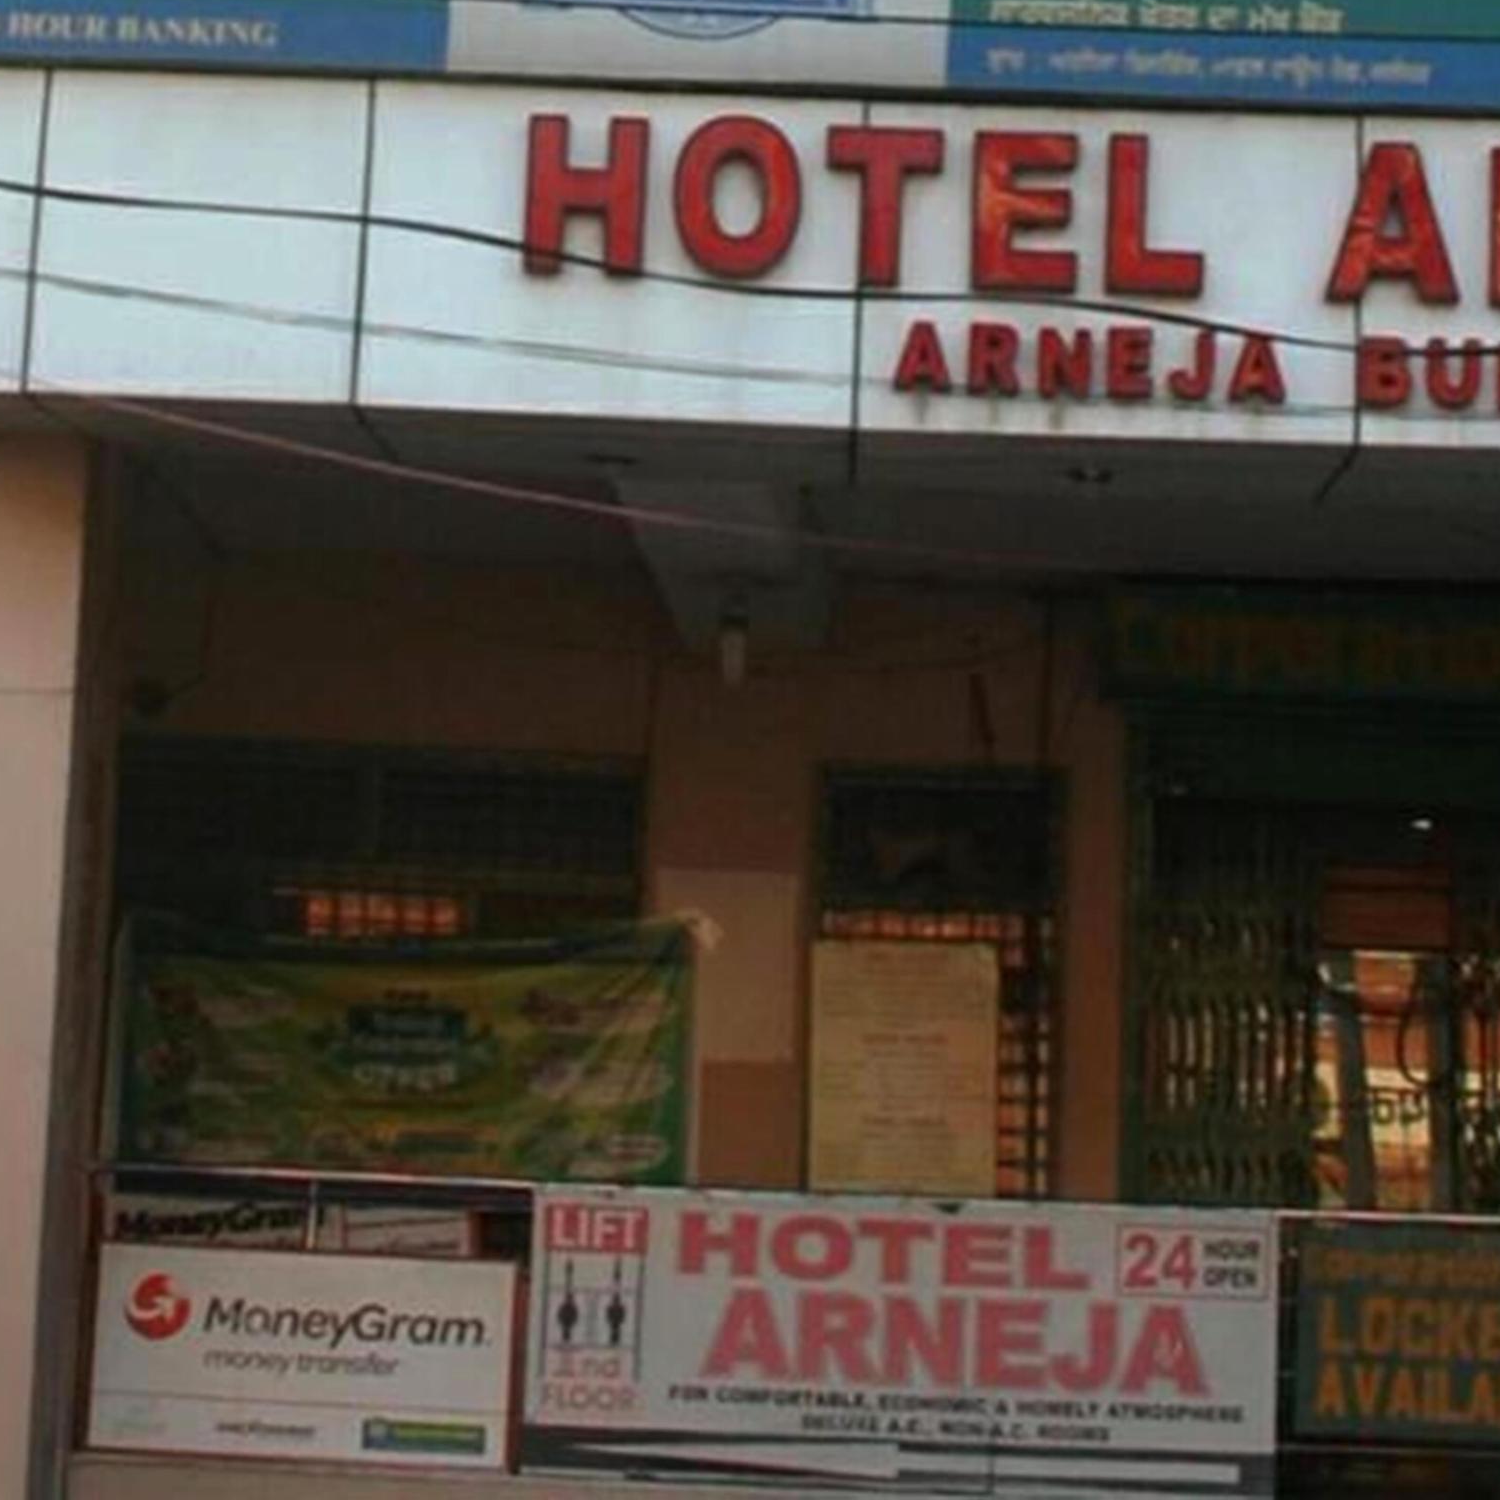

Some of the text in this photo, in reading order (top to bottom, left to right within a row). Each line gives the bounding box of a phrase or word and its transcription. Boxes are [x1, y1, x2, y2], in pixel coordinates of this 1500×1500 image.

[6, 10, 107, 42] HOUR
[116, 13, 279, 48] BANKING
[522, 114, 1204, 298] HOTEL
[894, 317, 1289, 404] ARNEJA
[552, 1208, 644, 1249] LIFT
[679, 1211, 1089, 1290] HOTEL
[1122, 1233, 1198, 1290] 24
[1204, 1240, 1260, 1262] HOUR
[1204, 1264, 1258, 1288] OPEN
[203, 1297, 486, 1349] MoneyGram
[702, 1289, 1209, 1395] ARNEJA
[204, 1347, 399, 1376] money transfer
[543, 1383, 637, 1412] FLOOR
[669, 1384, 709, 1402] FOR
[1017, 1398, 1099, 1420] HOMELY
[1107, 1402, 1245, 1424] ATMOSPHERE
